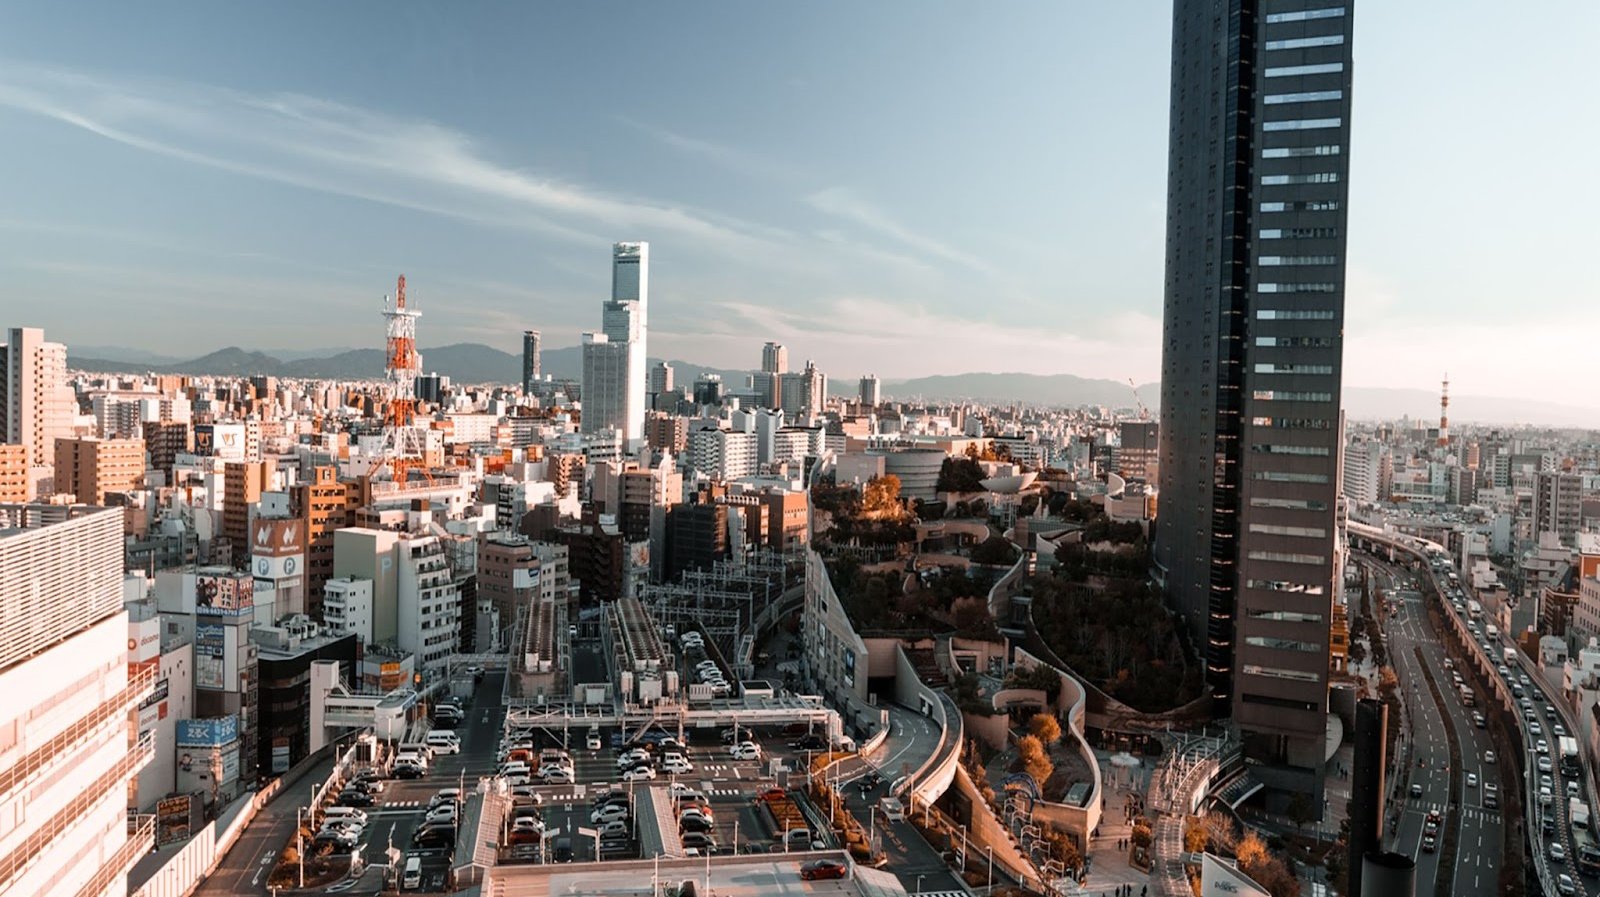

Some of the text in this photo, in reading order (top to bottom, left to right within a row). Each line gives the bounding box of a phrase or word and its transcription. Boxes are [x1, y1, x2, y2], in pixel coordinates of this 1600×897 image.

[381, 556, 393, 577] P
[141, 633, 159, 646] docomo
[140, 712, 158, 726] docomo
